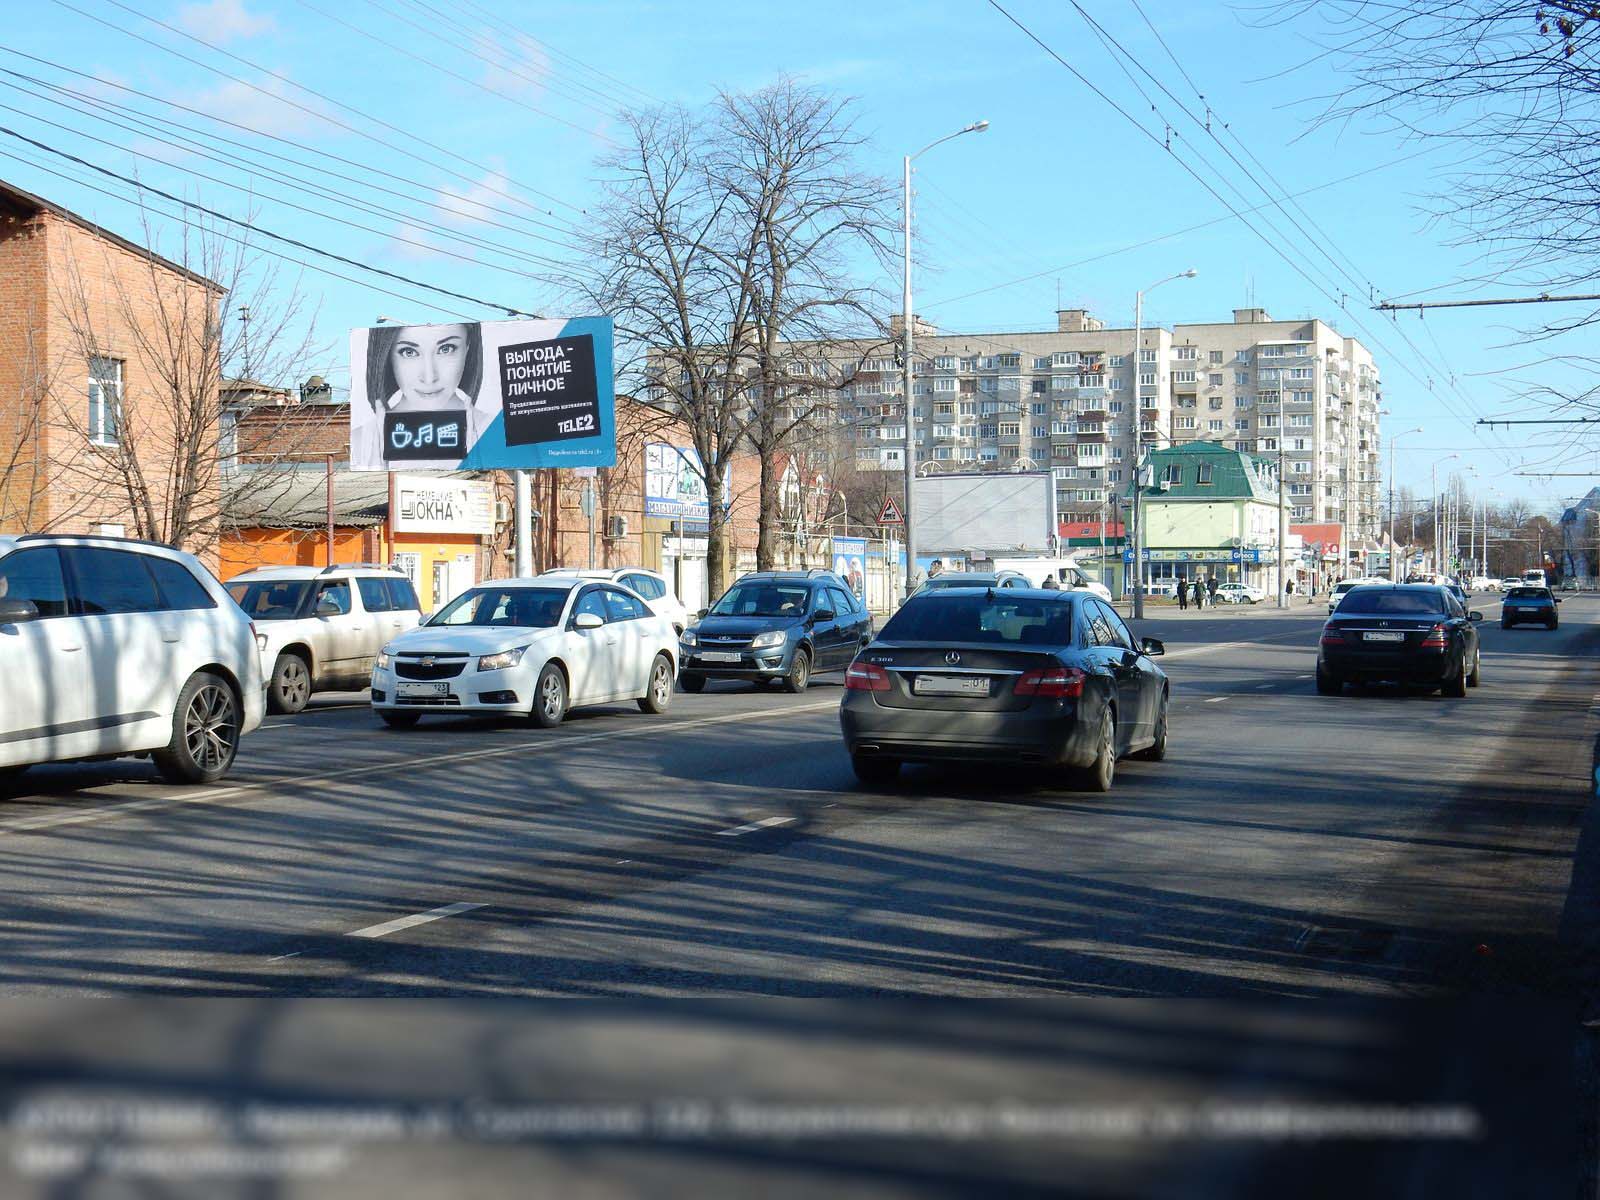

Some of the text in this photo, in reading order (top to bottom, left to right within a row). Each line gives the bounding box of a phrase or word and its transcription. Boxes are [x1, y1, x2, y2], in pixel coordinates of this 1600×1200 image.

[505, 346, 564, 364] ВЫГОДА
[506, 360, 572, 380] ПОНЯТИЕ
[508, 377, 565, 396] ЛИЧНОЕ
[557, 414, 595, 433] TELE2
[416, 501, 454, 520] ОКНА
[1233, 551, 1255, 559] Grece
